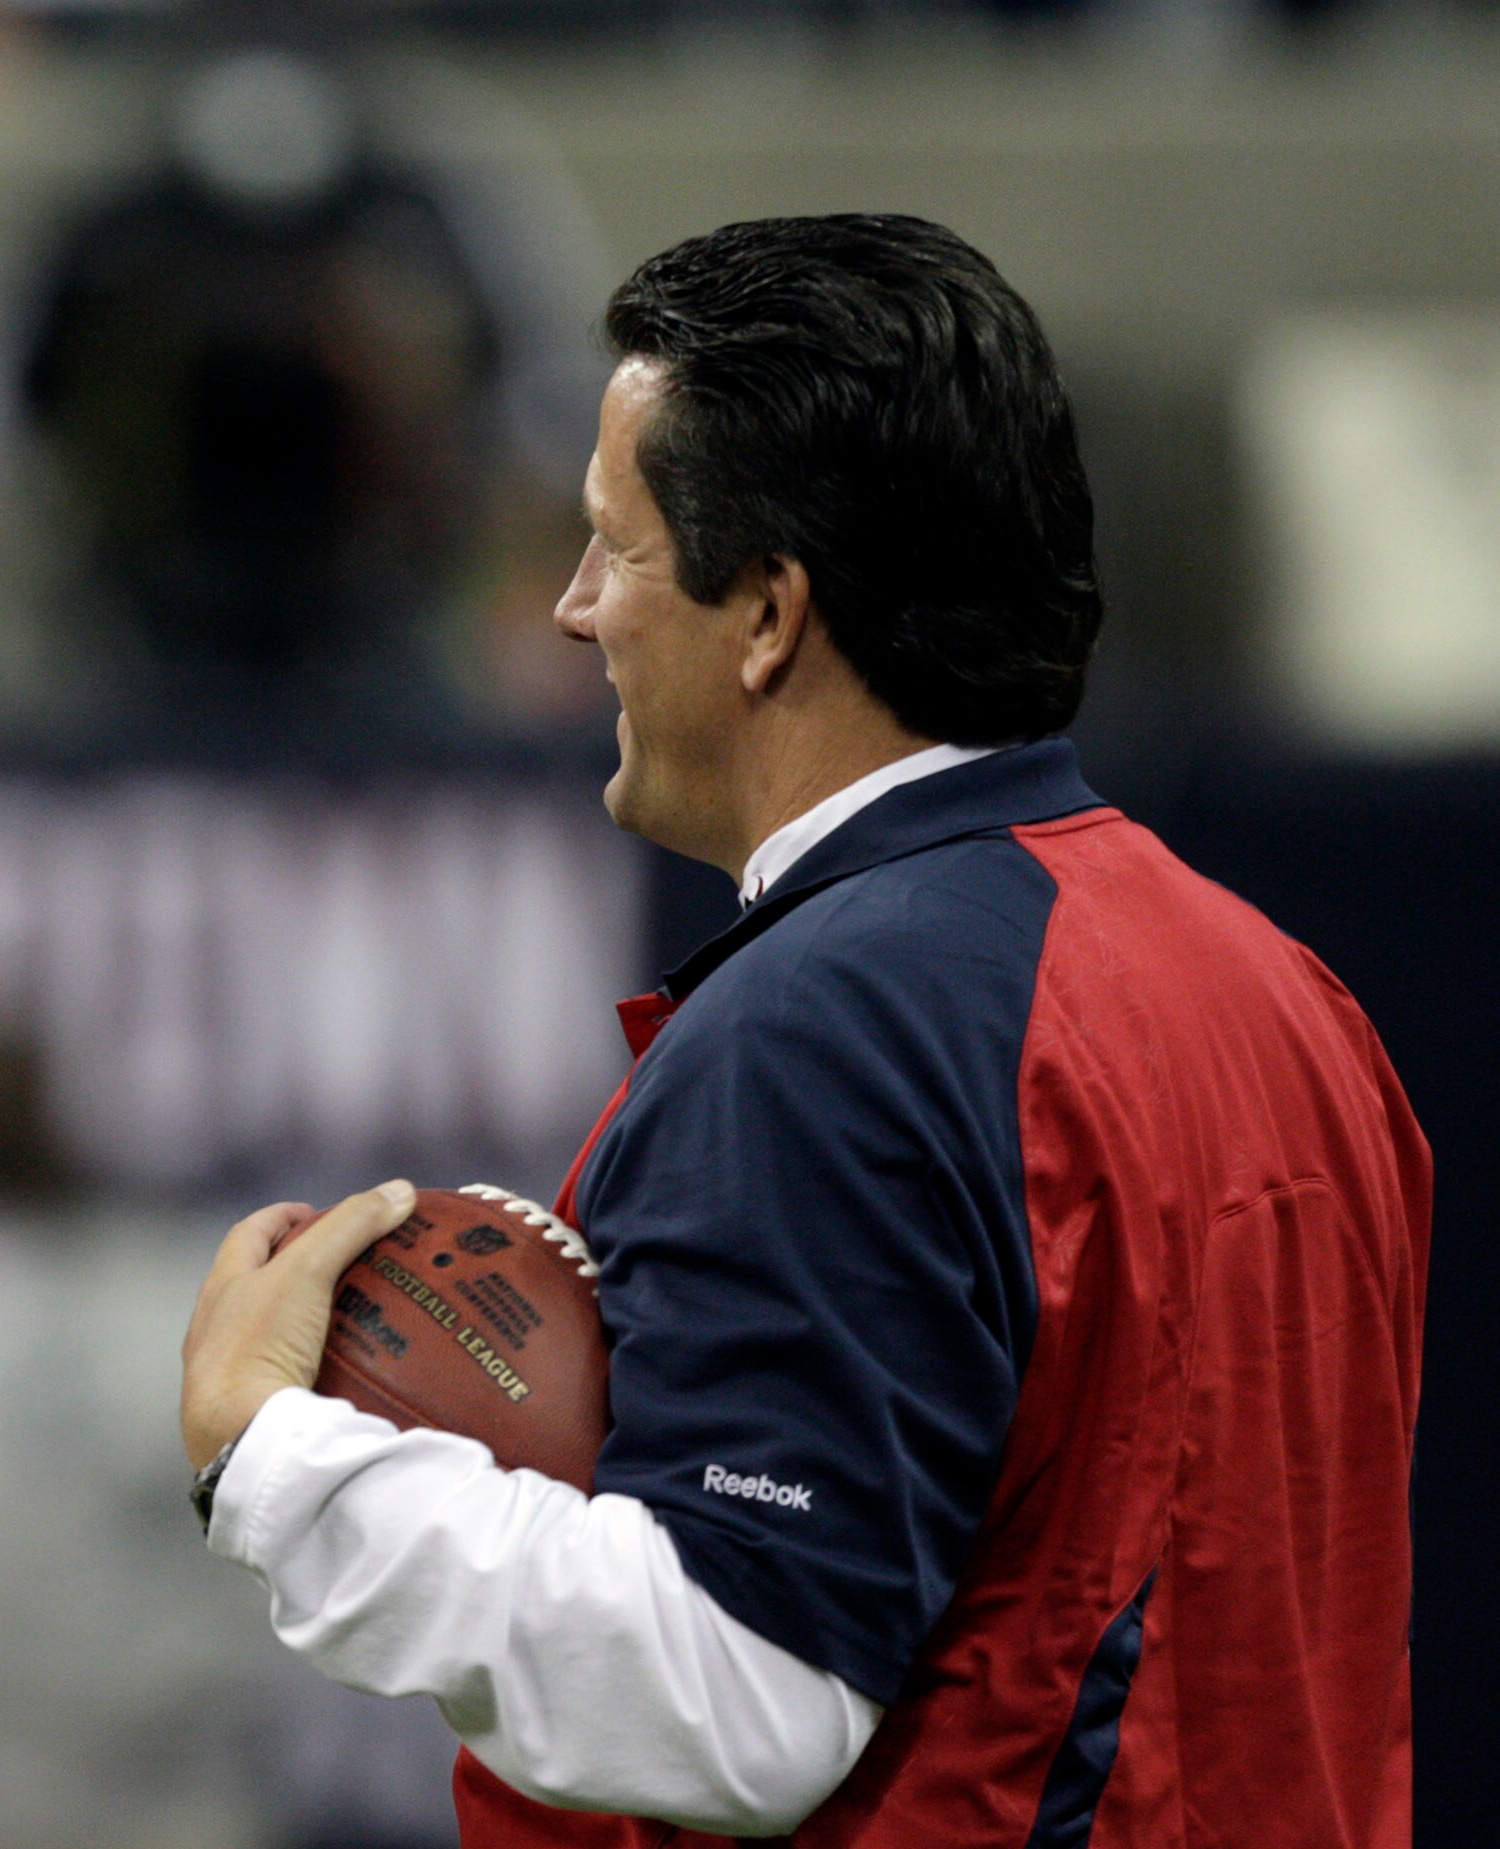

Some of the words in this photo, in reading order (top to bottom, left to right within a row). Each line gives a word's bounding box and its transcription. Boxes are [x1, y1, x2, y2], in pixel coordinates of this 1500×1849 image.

[373, 1257, 460, 1331] FOOTBALL
[456, 1326, 531, 1402] LEAGUE
[702, 1463, 813, 1512] Reebok
